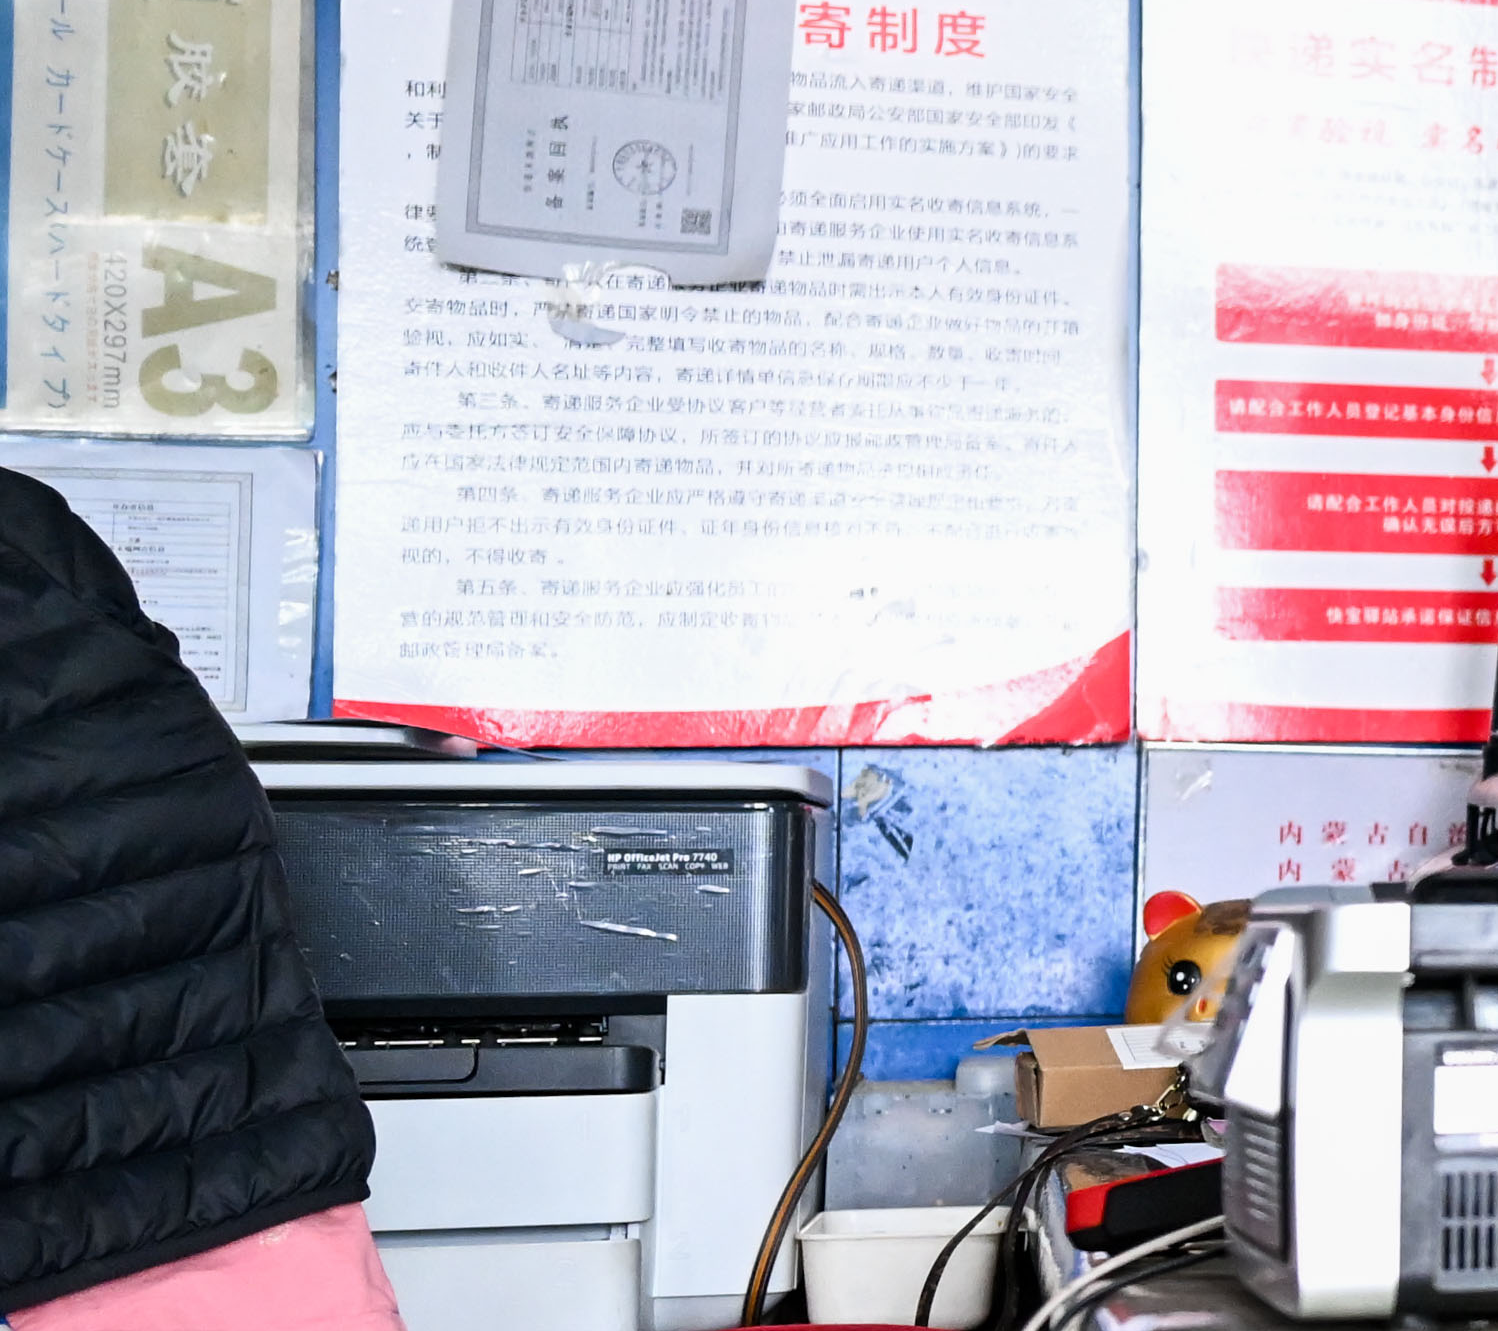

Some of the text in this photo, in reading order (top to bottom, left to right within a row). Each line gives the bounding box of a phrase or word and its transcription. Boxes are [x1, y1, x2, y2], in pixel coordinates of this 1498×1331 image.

[799, 0, 987, 59] 寄制度
[101, 253, 128, 411] 420X297mm
[138, 241, 279, 418] A3
[1279, 820, 1468, 846] 内蒙古自治
[607, 851, 718, 863] HP OfficeJet Pro 7740
[636, 862, 653, 871] FAX
[658, 862, 679, 871] SCAN
[1278, 857, 1409, 882] 内蒙古
